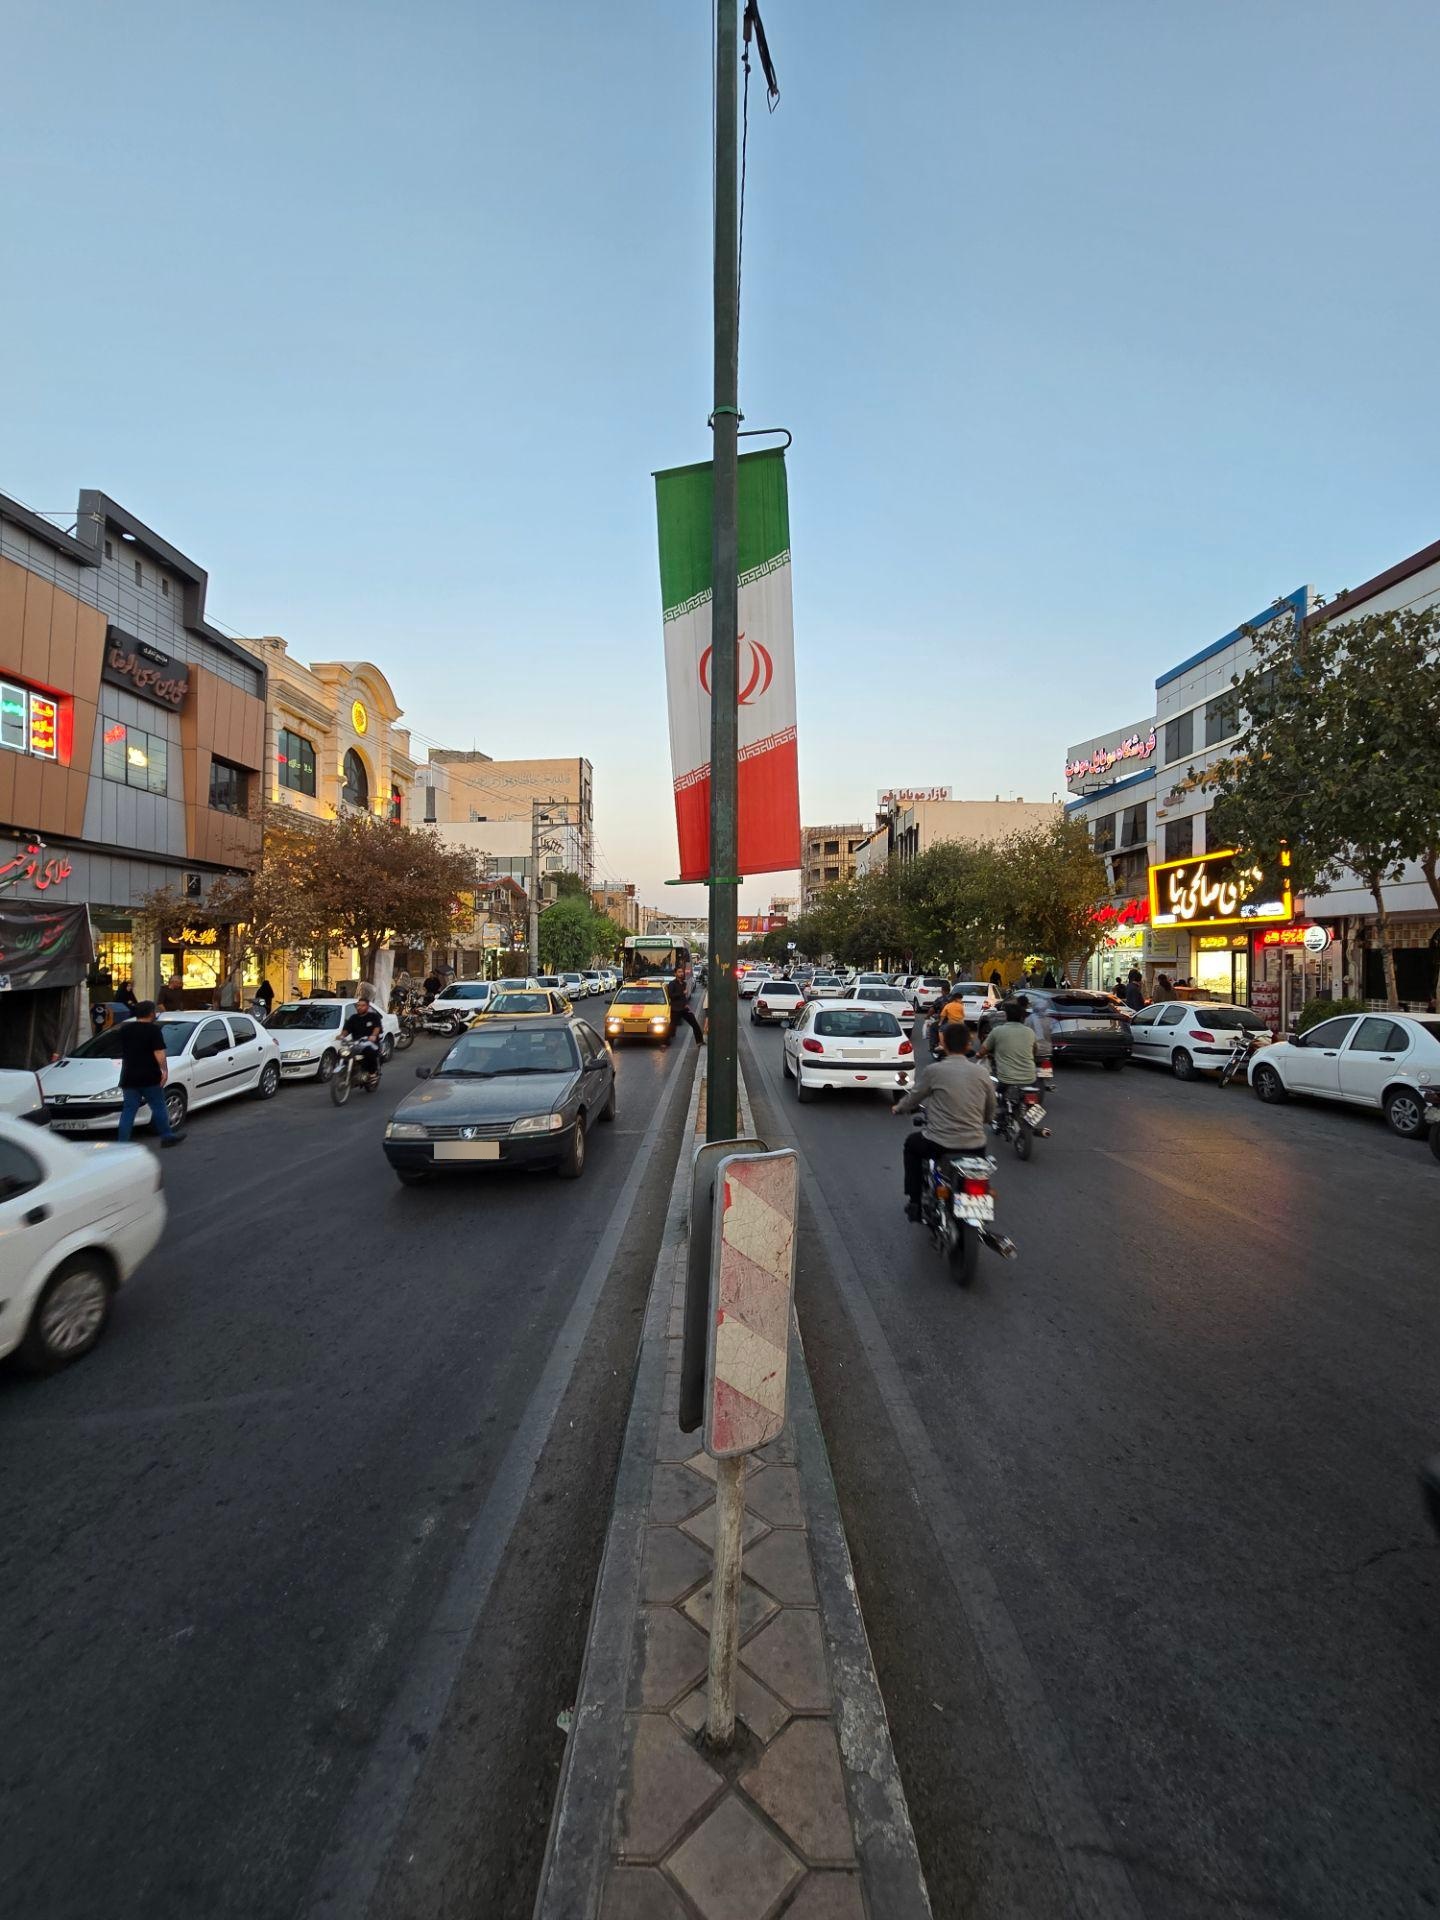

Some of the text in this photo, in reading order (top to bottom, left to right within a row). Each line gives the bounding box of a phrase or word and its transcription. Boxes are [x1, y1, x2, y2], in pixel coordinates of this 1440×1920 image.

[1115, 726, 1156, 760] فروشگاه
[1089, 748, 1116, 773] موبایل
[882, 790, 894, 803] قم
[928, 787, 947, 801] بازار
[0, 844, 40, 885] توح
[1169, 868, 1185, 915] نیا
[1181, 862, 1221, 919] صالحی
